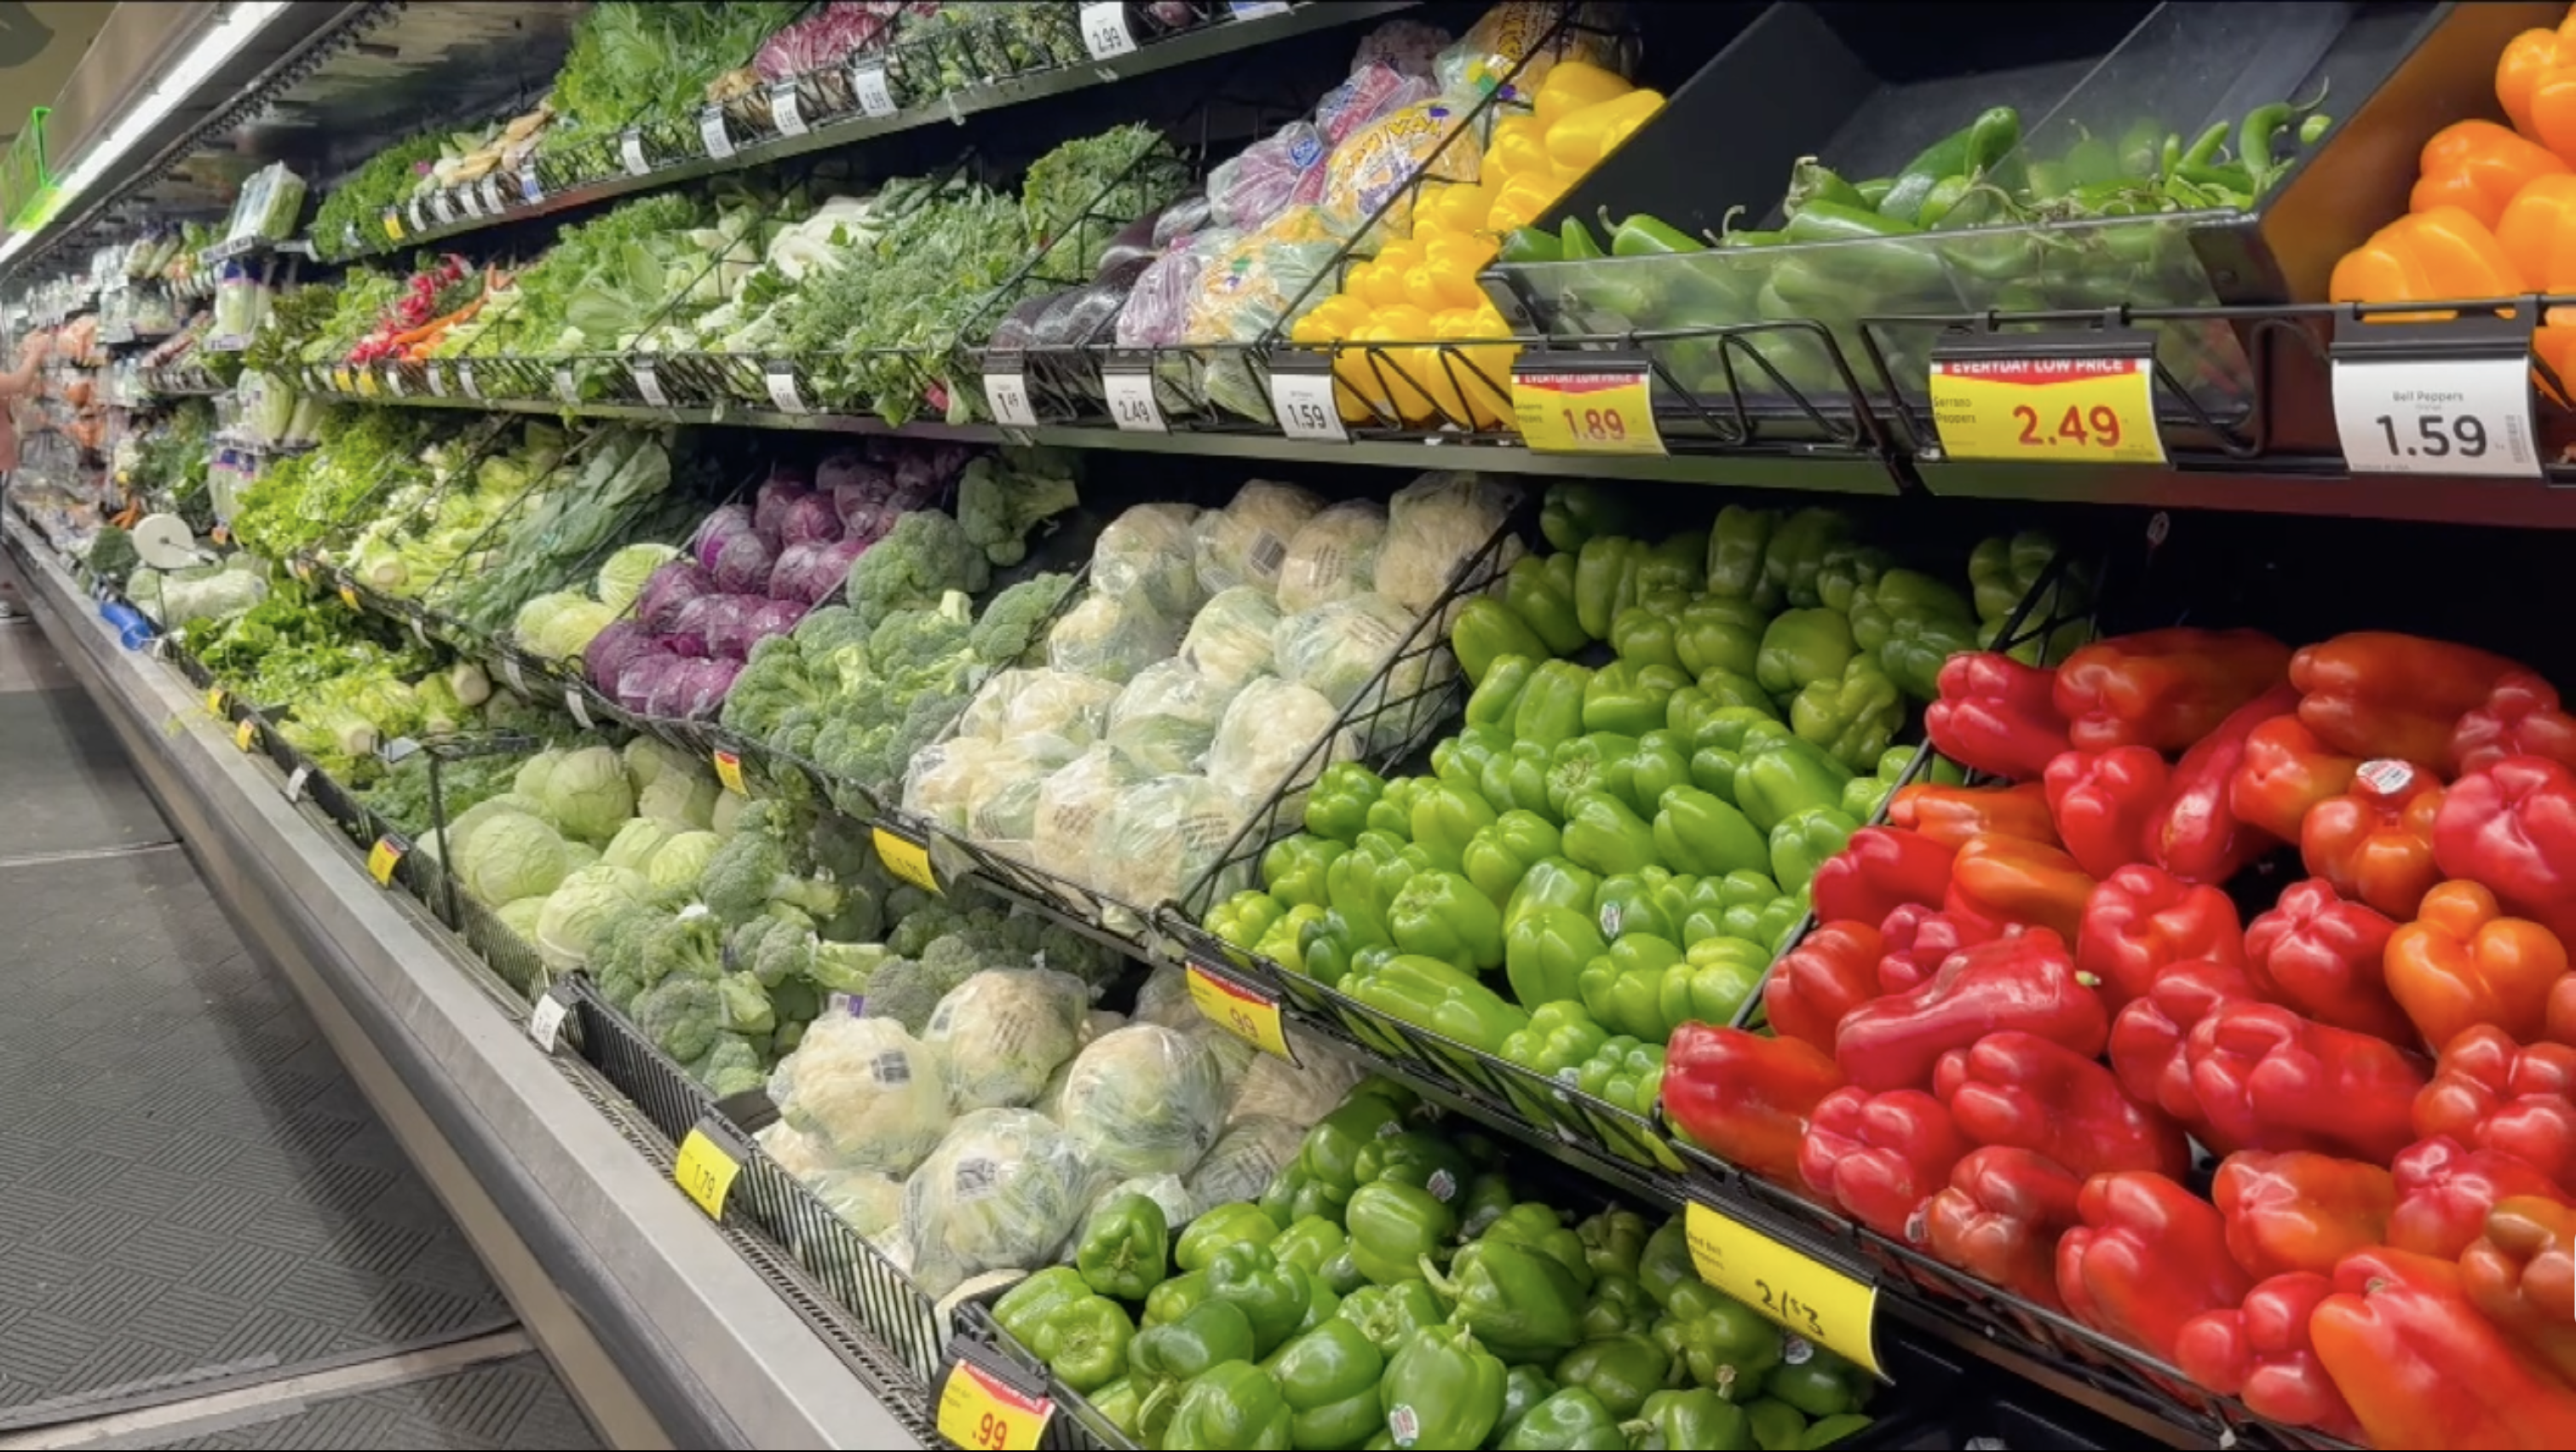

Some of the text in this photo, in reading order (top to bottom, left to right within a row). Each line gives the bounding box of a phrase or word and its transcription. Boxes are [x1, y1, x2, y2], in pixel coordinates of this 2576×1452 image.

[2392, 390, 2464, 404] Bell Peppers
[1118, 400, 1150, 424] 2.49
[1287, 404, 1326, 429] 1.59
[1563, 408, 1626, 441] 1.89
[2013, 405, 2121, 448] 2.49
[2375, 414, 2487, 458] 1.59
